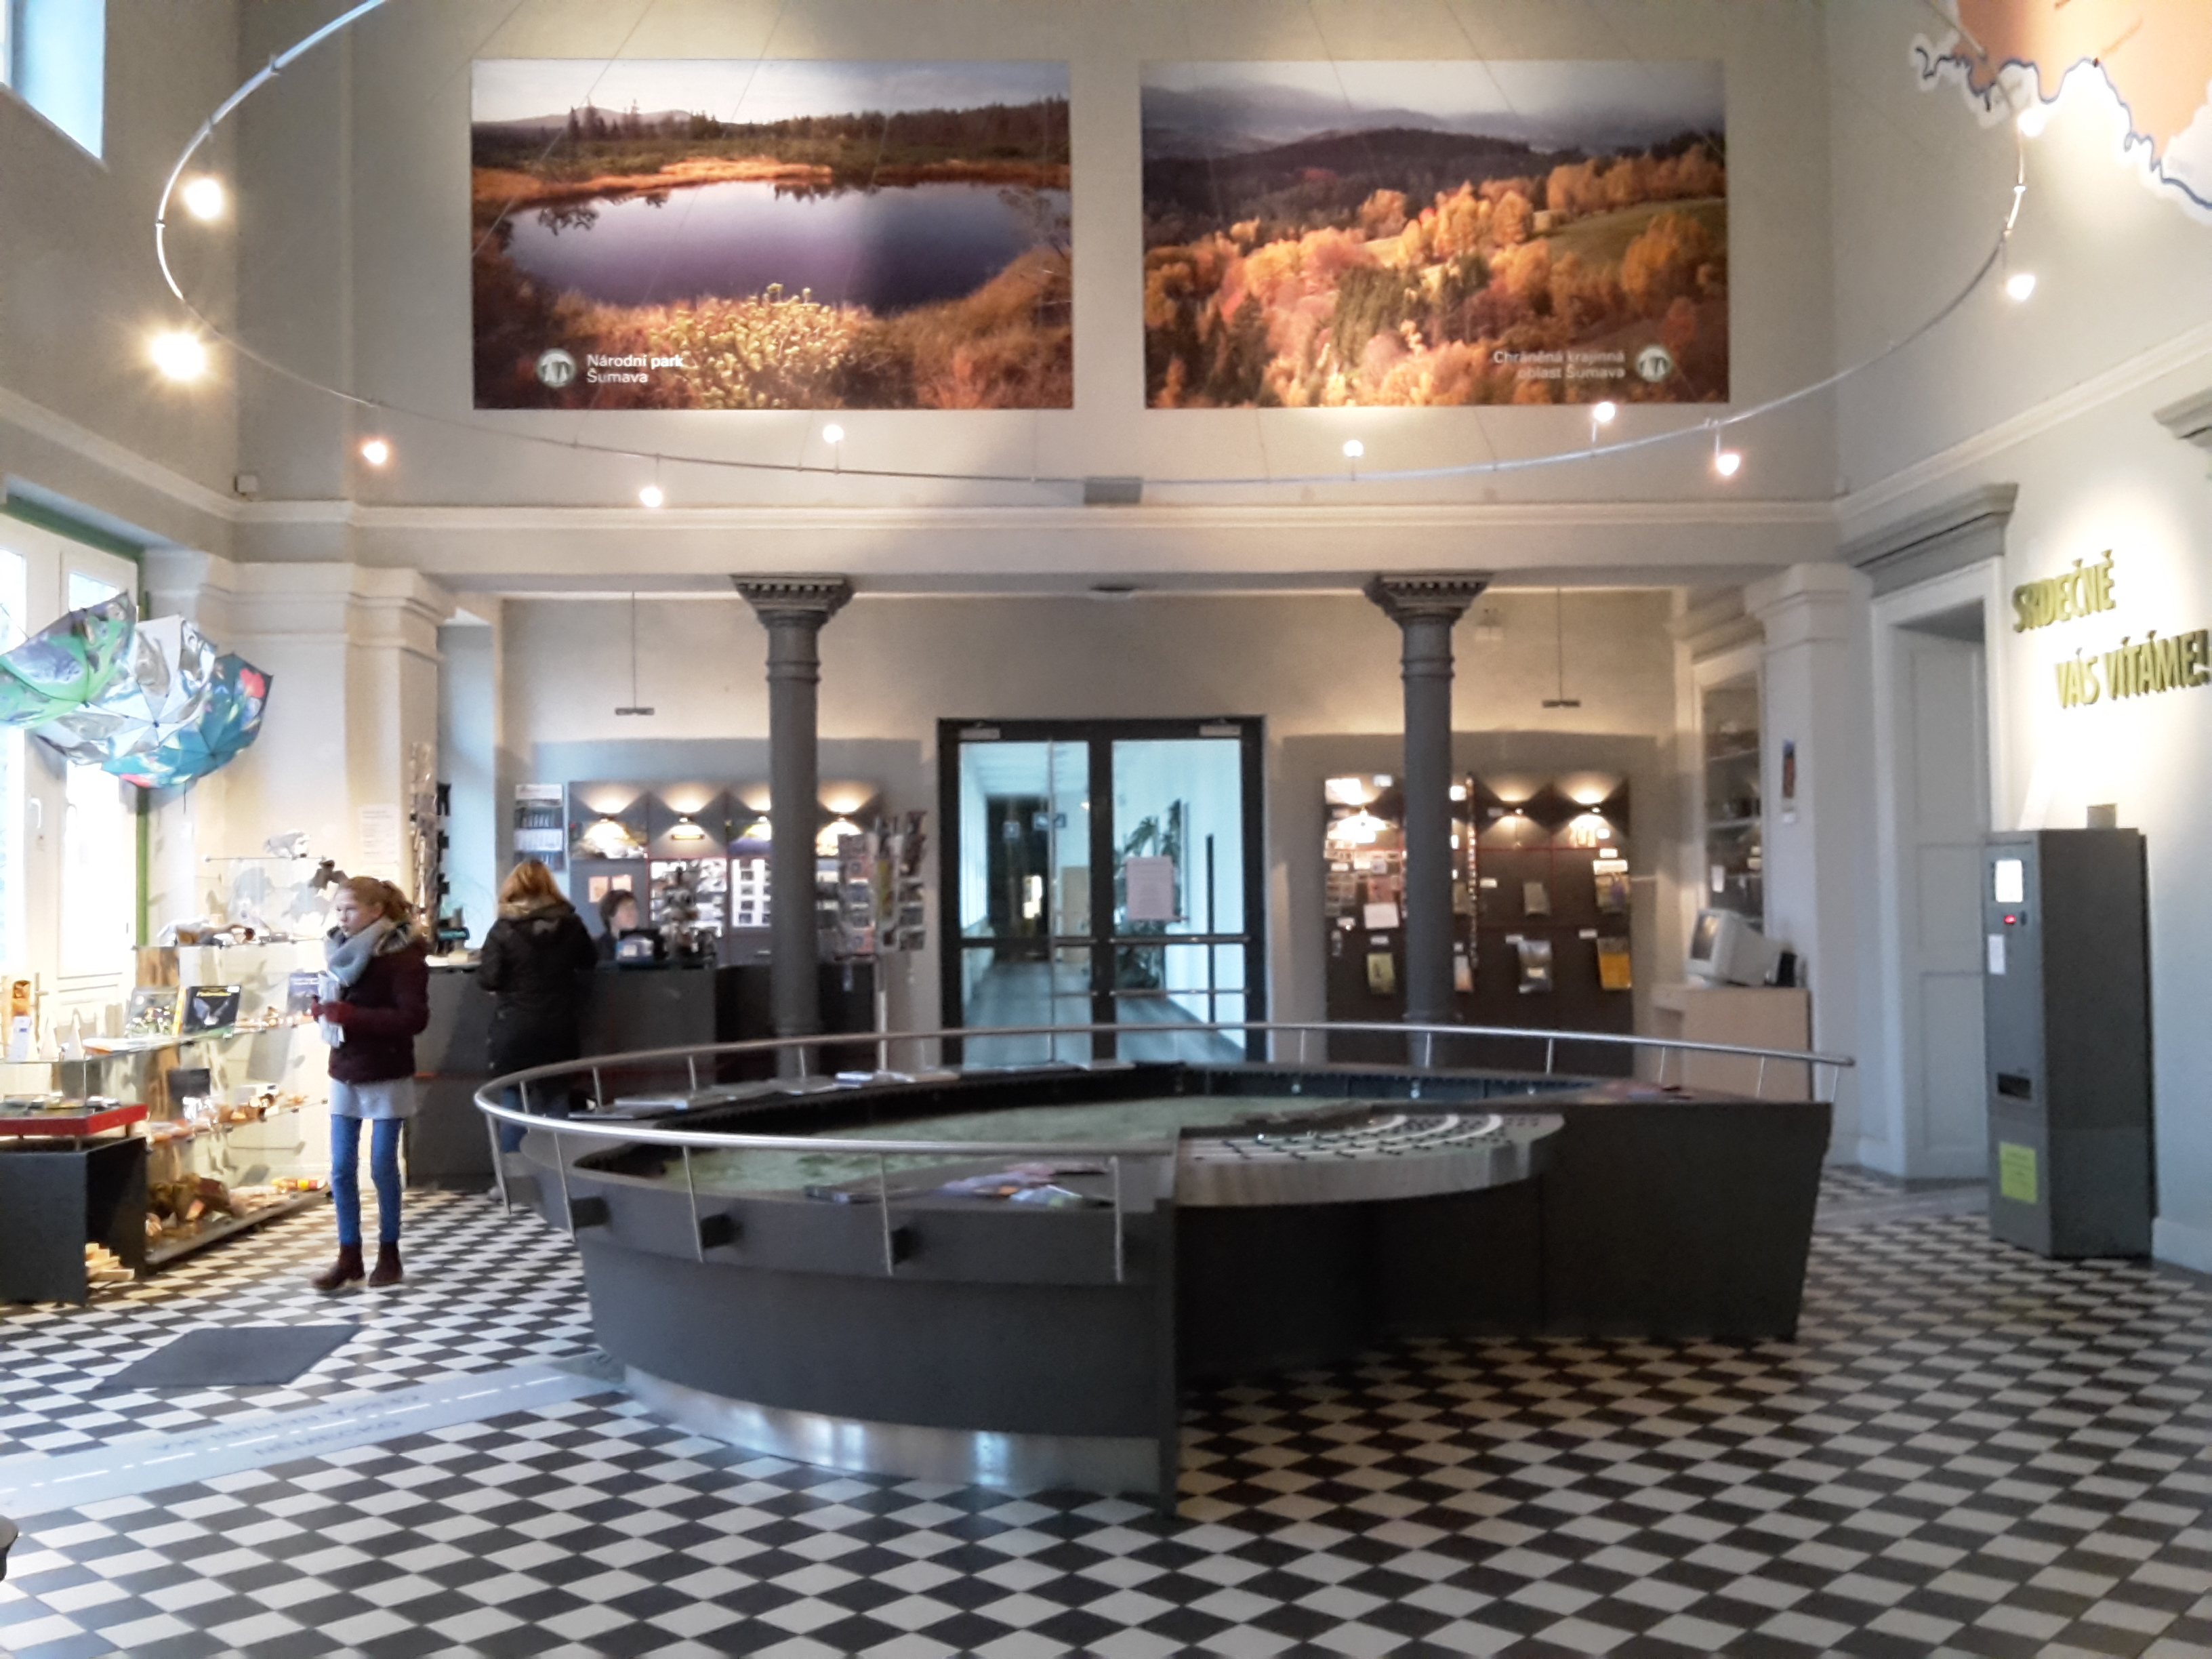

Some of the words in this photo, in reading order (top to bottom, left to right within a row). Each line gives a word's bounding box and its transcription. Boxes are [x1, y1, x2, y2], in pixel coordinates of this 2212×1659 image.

[586, 354, 647, 367] Národní
[651, 354, 684, 369] park
[586, 368, 649, 383] Šumava
[1517, 366, 1561, 379] oblast
[1565, 364, 1626, 379] Šumava
[2012, 549, 2116, 633] SRDEČNĚ
[2055, 647, 2101, 710] VÁS
[2102, 629, 2212, 701] VÍTÁME!
